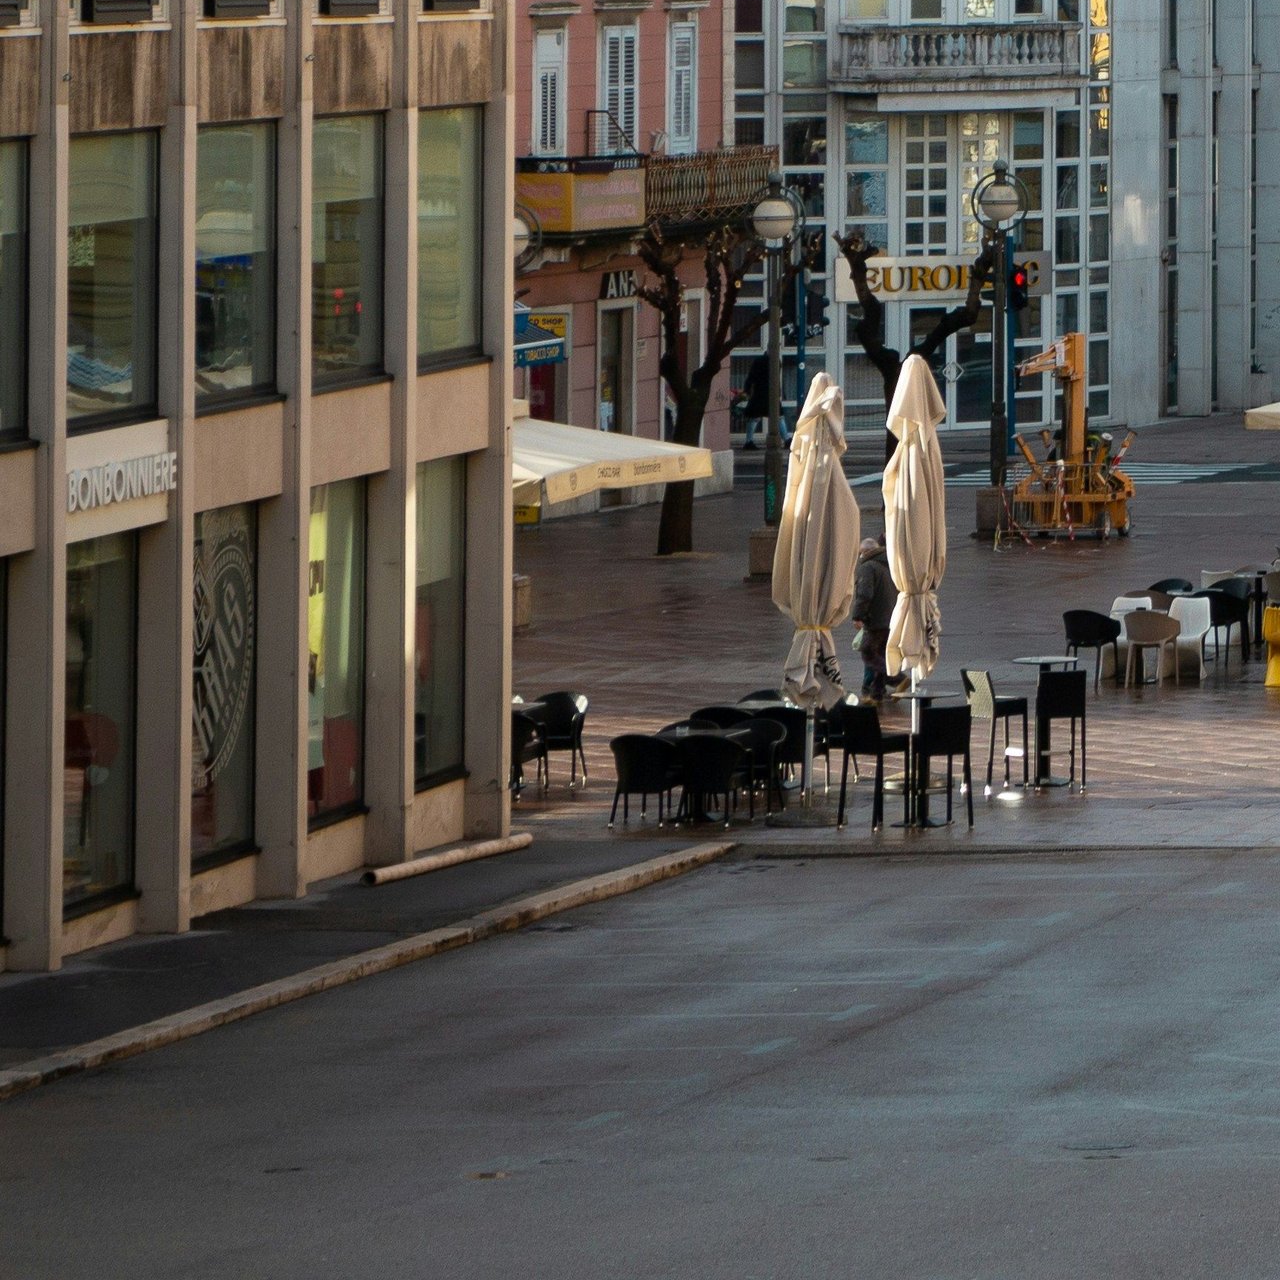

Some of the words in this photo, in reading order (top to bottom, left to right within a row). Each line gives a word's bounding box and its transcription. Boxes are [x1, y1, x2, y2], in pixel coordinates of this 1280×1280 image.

[542, 317, 563, 325] SHOP
[546, 345, 560, 359] SHOP
[68, 451, 177, 513] BONBONNIERE
